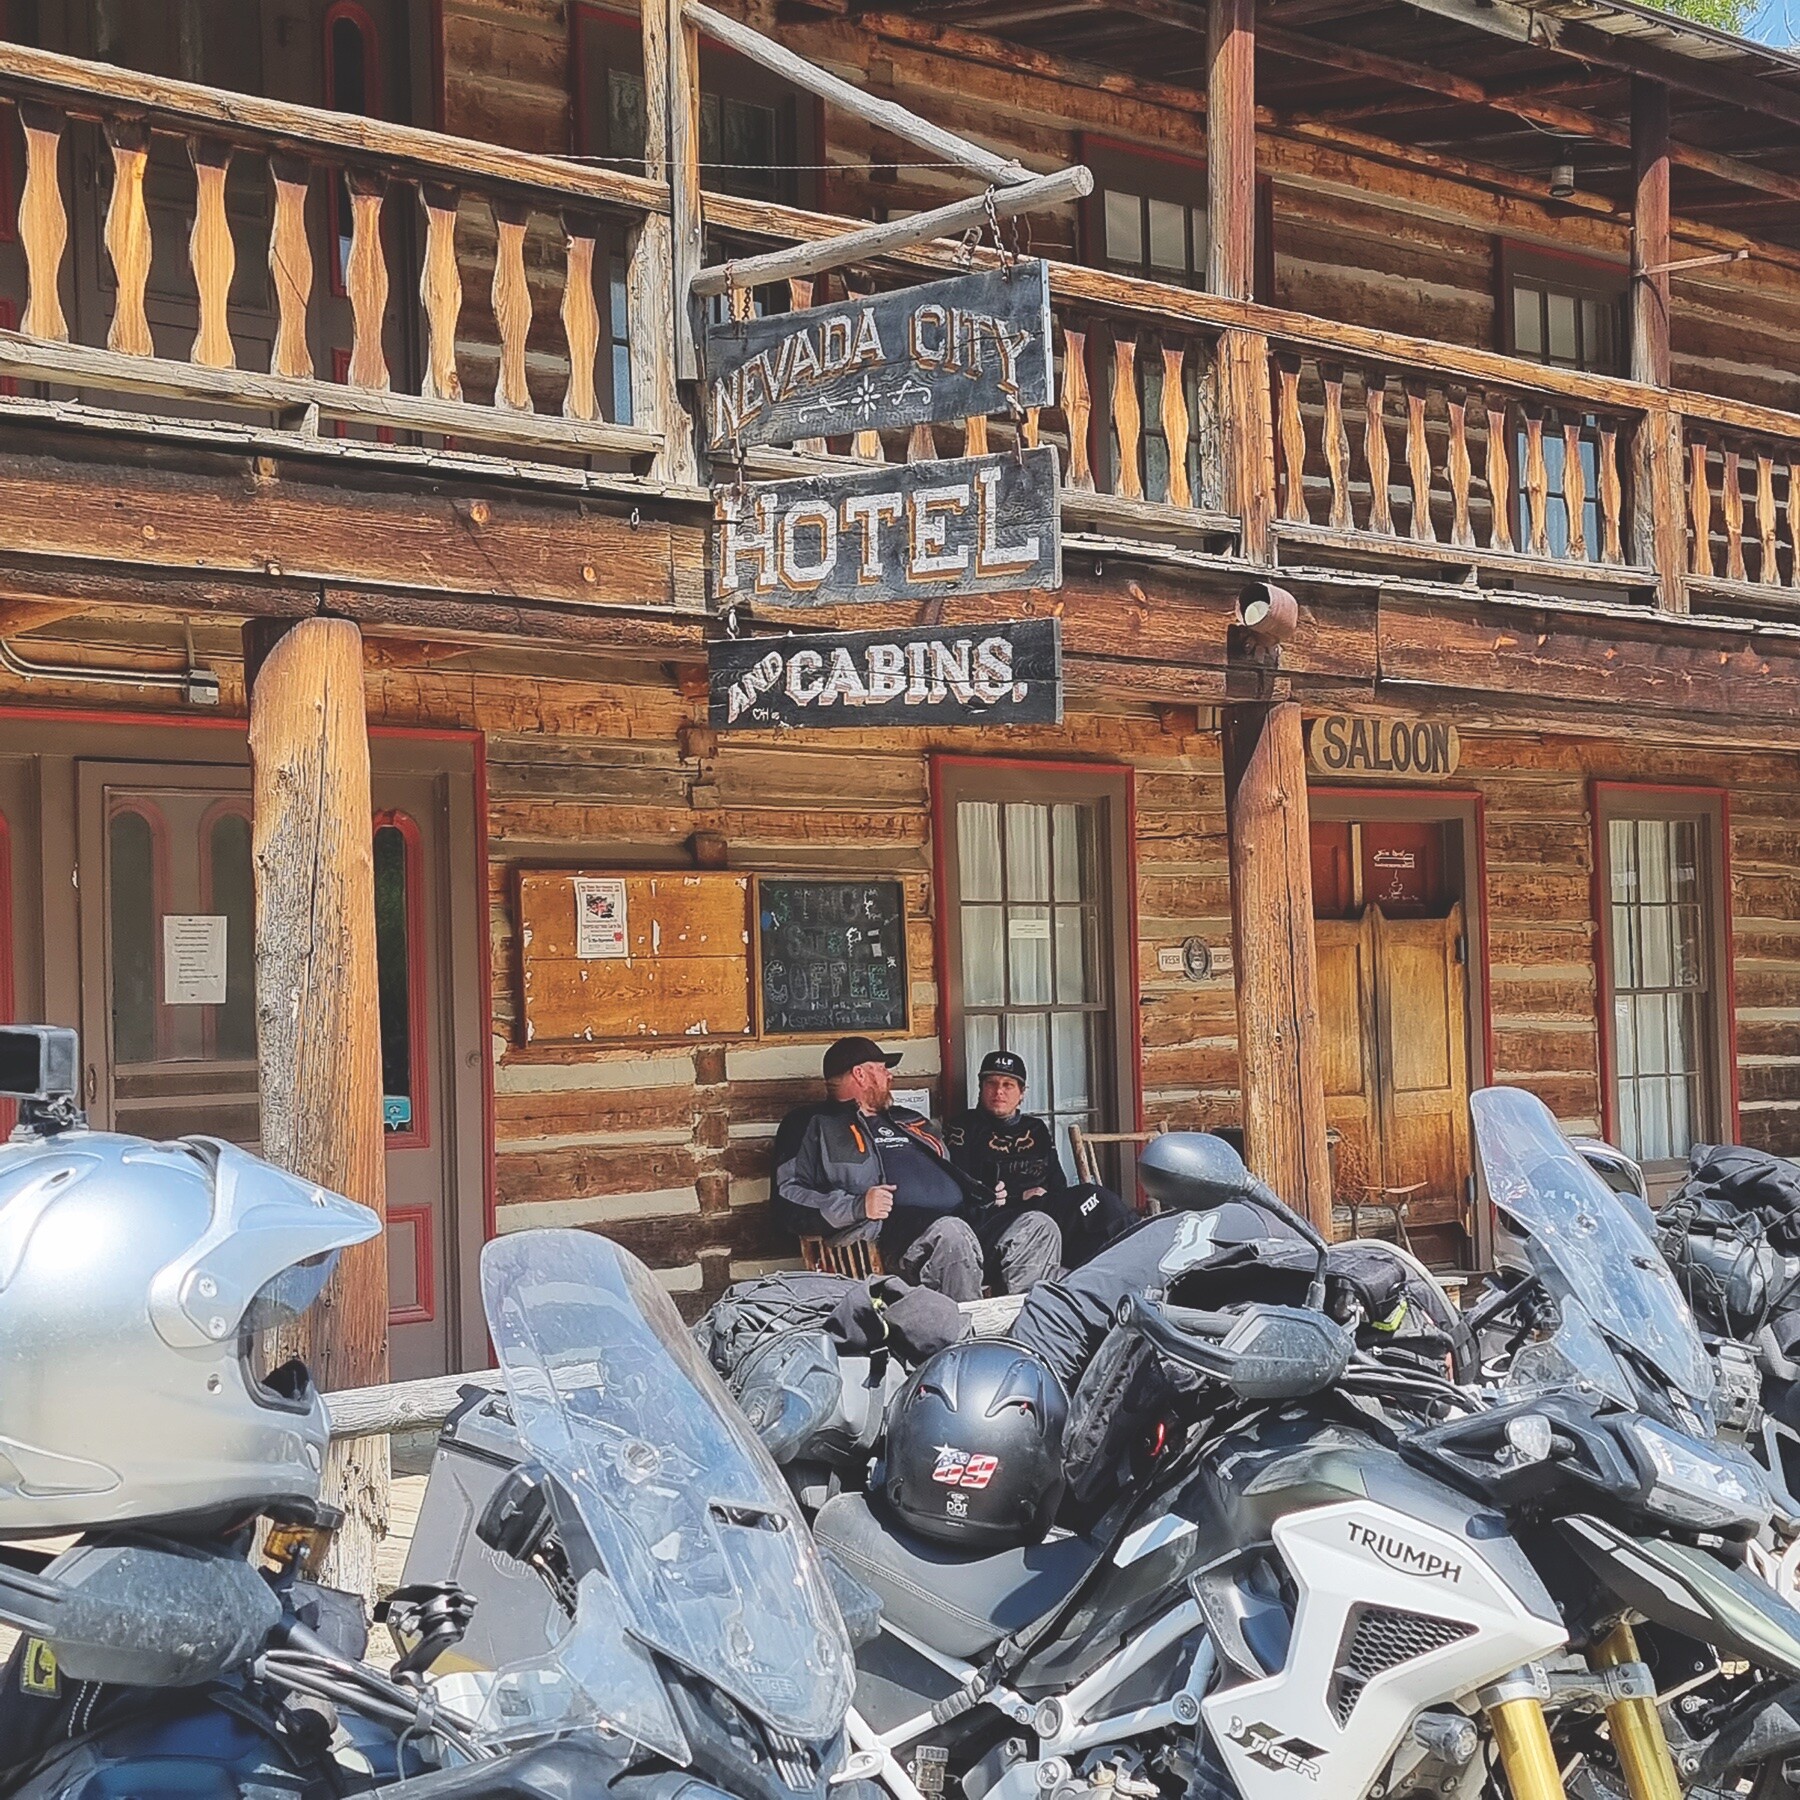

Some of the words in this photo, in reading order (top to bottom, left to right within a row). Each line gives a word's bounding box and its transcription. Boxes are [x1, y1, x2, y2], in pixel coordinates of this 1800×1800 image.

[710, 306, 887, 449] NEVADA
[909, 303, 1031, 393] CITY
[715, 465, 1040, 598] HOTEL
[728, 650, 783, 724] AND
[1322, 715, 1450, 774] SALOON
[764, 960, 890, 1004] COFFEE
[1080, 1193, 1100, 1216] FOX
[946, 1501, 968, 1514] DOT
[1348, 1522, 1462, 1583] TRIUMPH
[1249, 1731, 1321, 1782] TIGER
